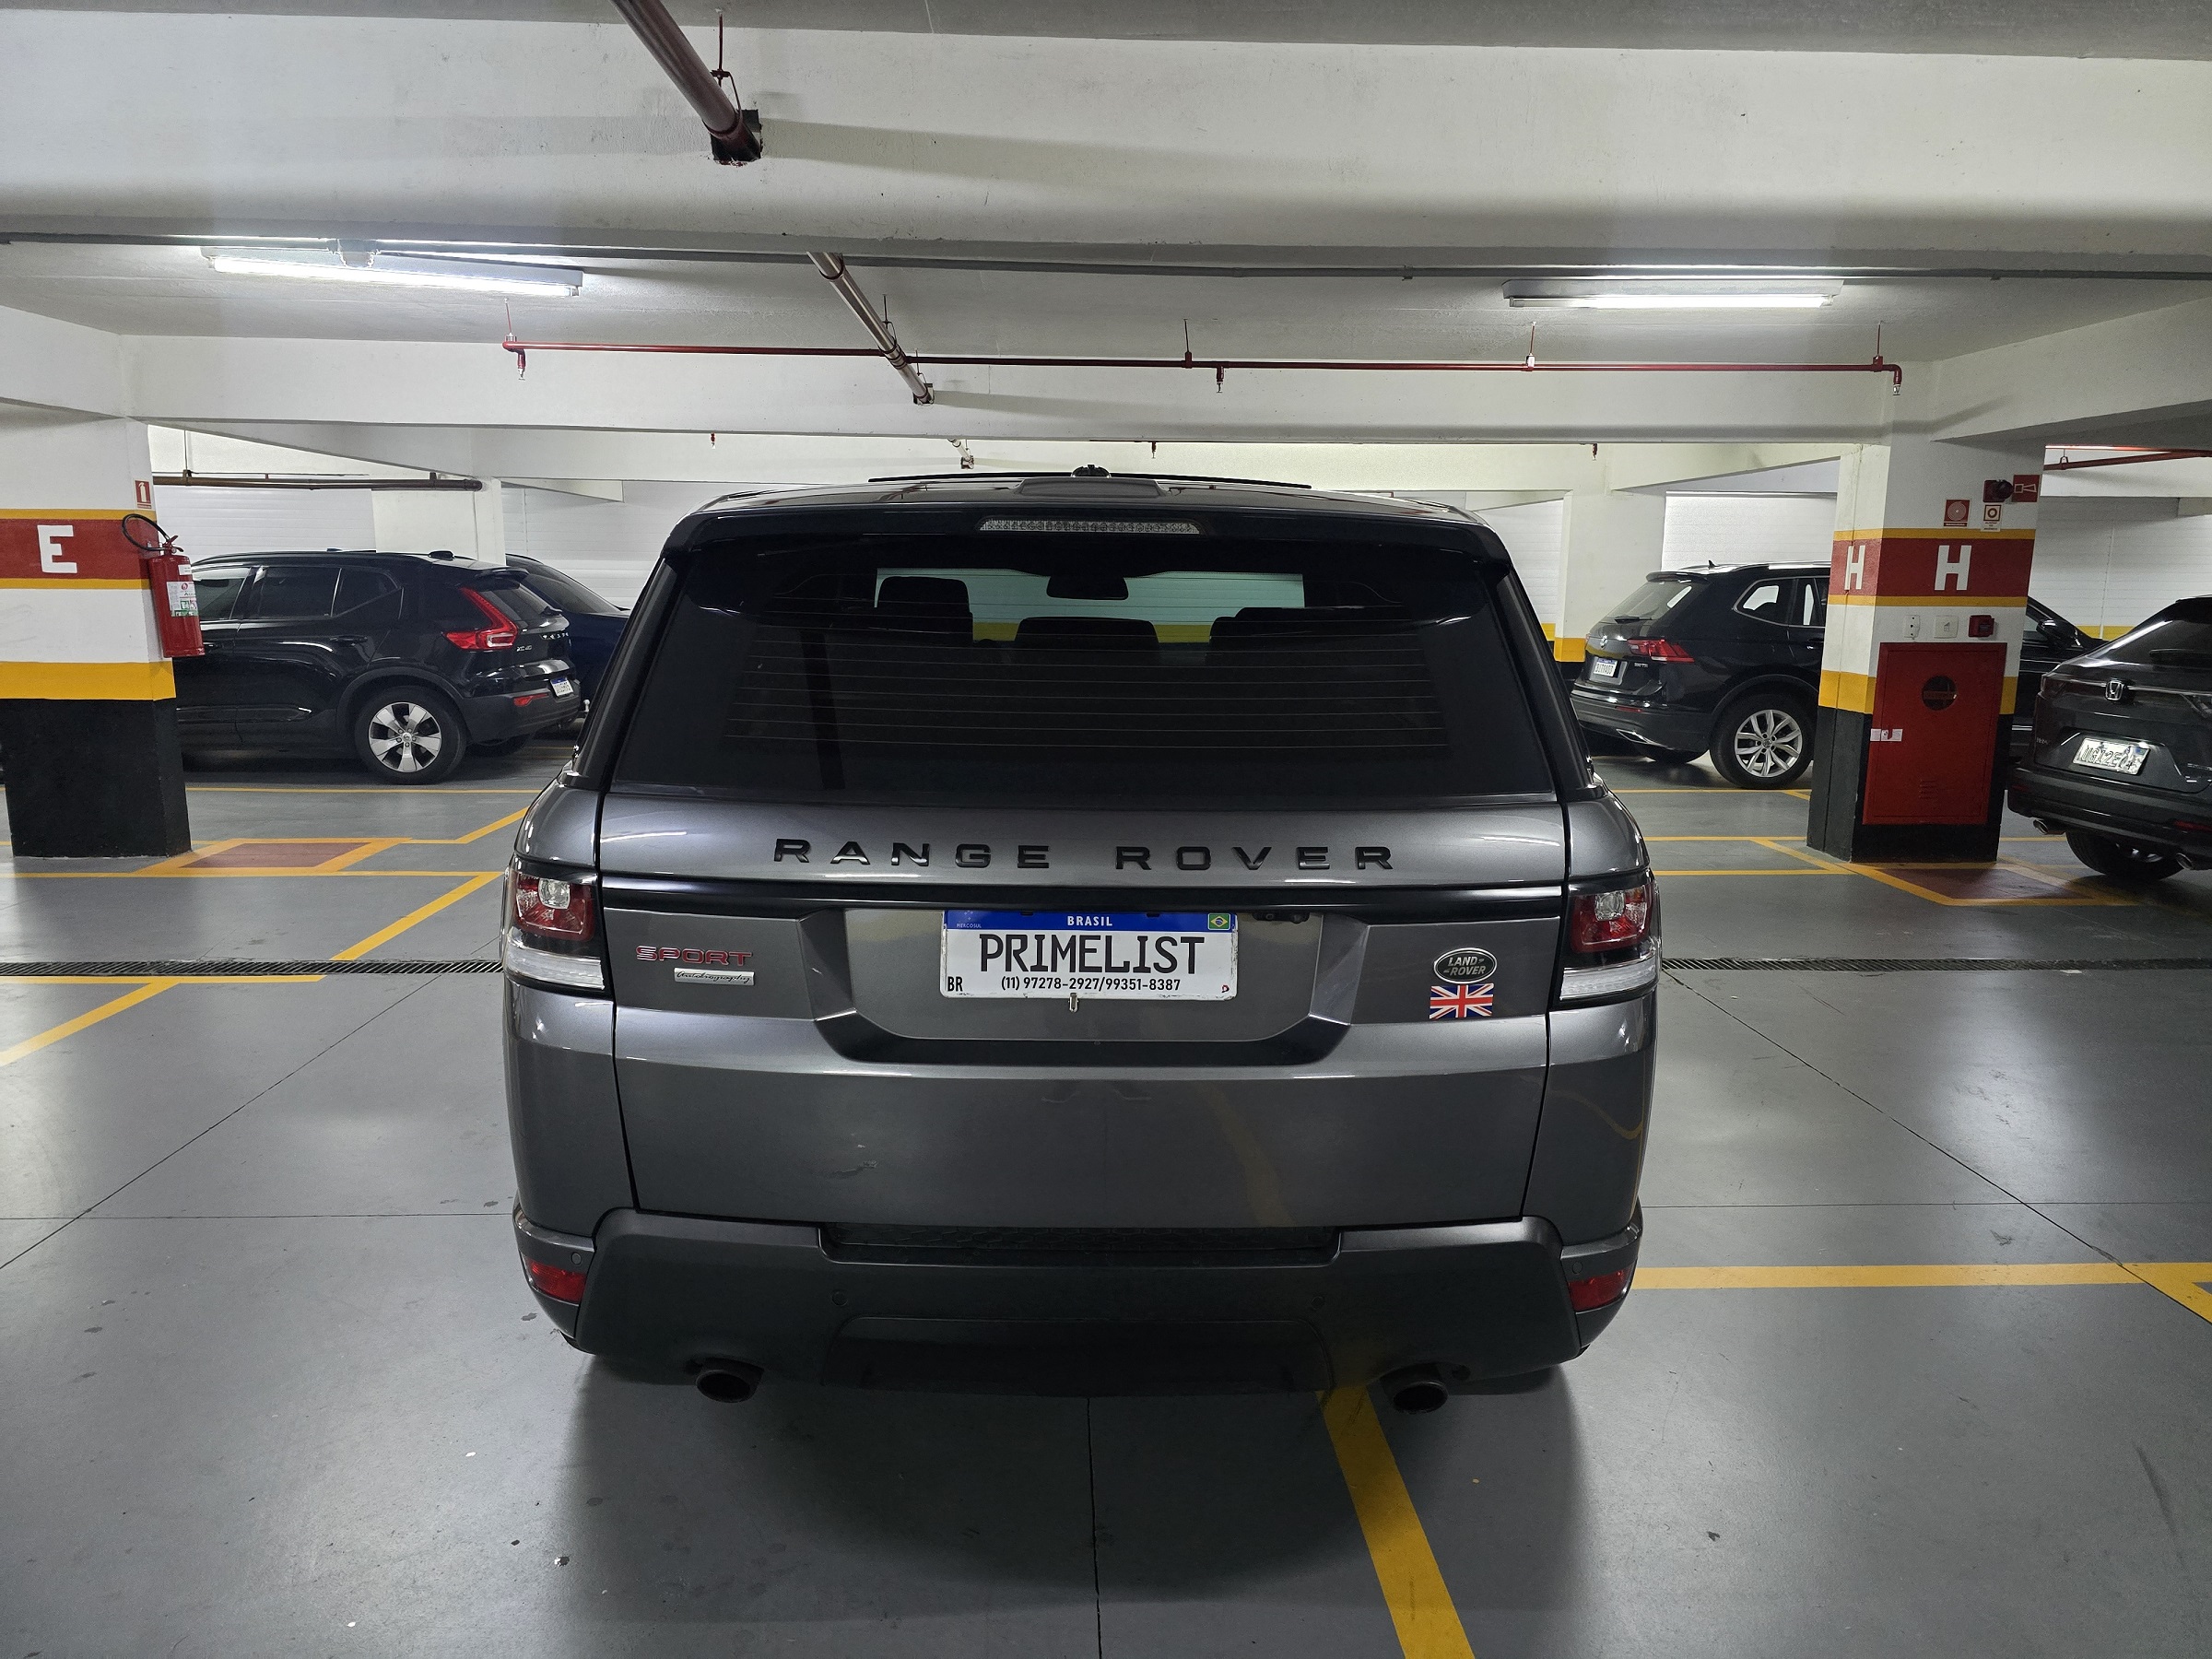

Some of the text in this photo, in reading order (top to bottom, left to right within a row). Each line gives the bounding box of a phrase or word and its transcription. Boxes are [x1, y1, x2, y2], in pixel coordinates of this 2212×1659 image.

[37, 524, 77, 573] E
[1844, 545, 1865, 591] H
[1935, 545, 1972, 591] H
[773, 838, 1394, 870] RANGE ROVER
[1067, 915, 1113, 926] BRASIL
[636, 945, 753, 966] SPORT
[979, 933, 1205, 974] PRIMELIST
[1448, 957, 1478, 967] LAND
[1450, 965, 1487, 976] ROVER
[947, 976, 963, 992] BR
[1001, 976, 1181, 992] (11) 97278-2927/99351-8387
